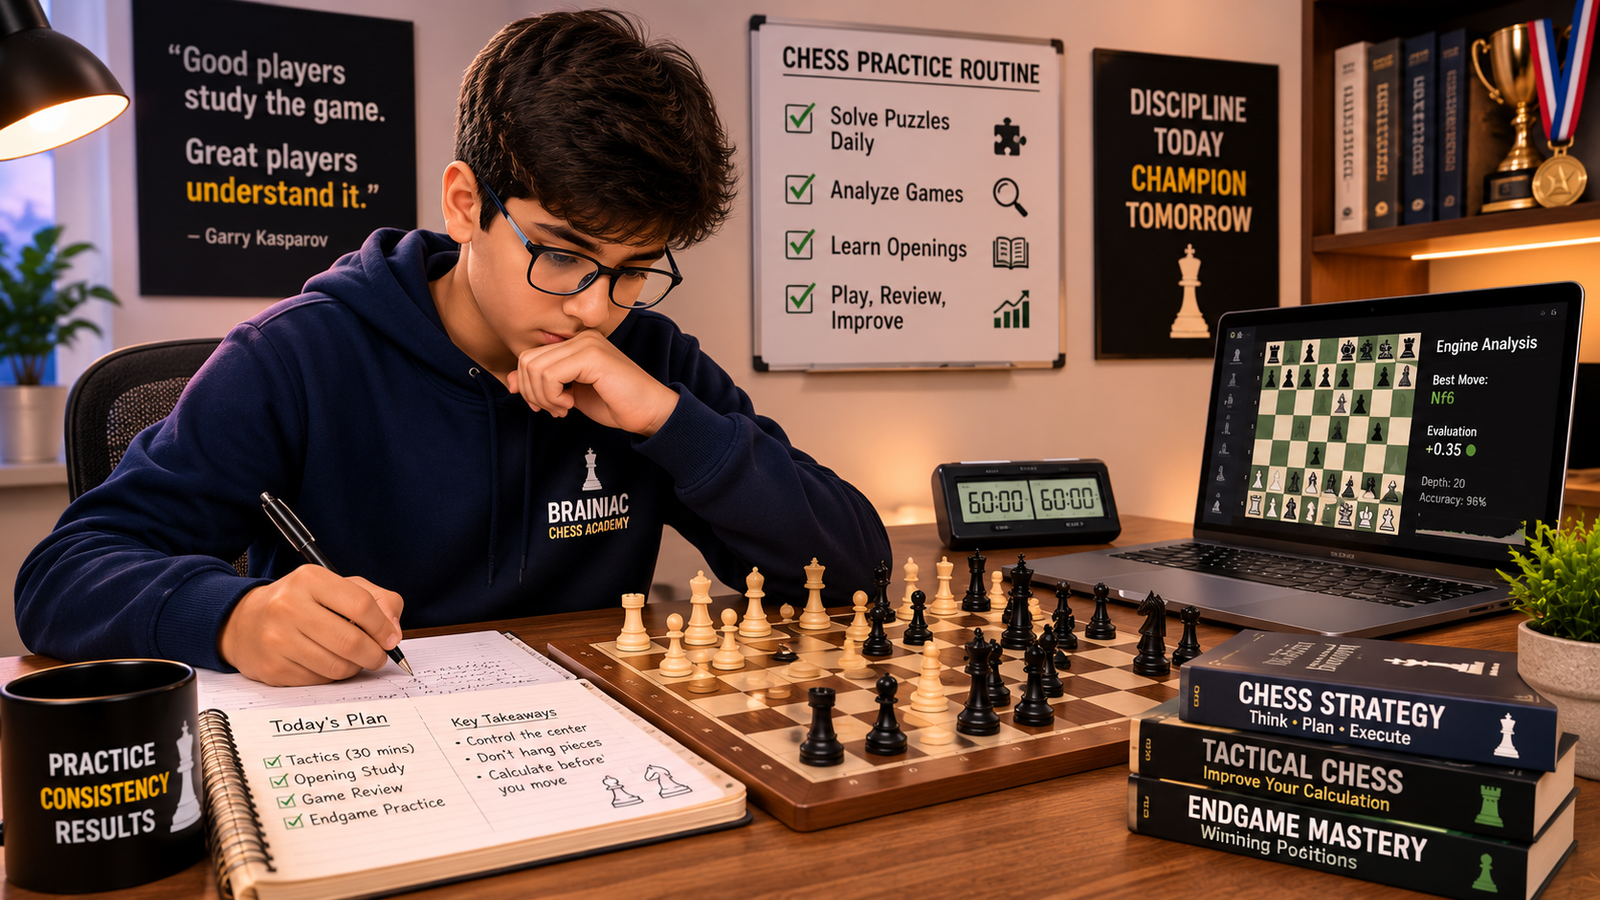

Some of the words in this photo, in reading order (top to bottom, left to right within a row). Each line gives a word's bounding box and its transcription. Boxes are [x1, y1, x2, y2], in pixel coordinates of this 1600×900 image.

[257, 52, 346, 87] players
[782, 46, 849, 71] CHESS
[857, 51, 952, 78] PRACTICE
[960, 59, 1040, 84] ROUTINE
[184, 86, 257, 119] study
[266, 89, 306, 116] the
[314, 97, 386, 124] game.
[1130, 88, 1247, 122] DISCIPLINE
[830, 106, 878, 127] Solve
[885, 109, 950, 130] Puzzles
[830, 132, 875, 156] Daily
[1154, 127, 1224, 157] TODAY
[186, 138, 258, 167] Great
[266, 143, 358, 177] players
[186, 176, 334, 208] understand
[830, 180, 900, 205] Analyze
[906, 183, 964, 203] Games
[1131, 164, 1247, 196] CHAMPION
[1126, 201, 1252, 233] TOMORROW
[205, 227, 251, 248] Garry
[256, 230, 328, 250] Kasparov
[831, 235, 881, 256] Learn
[887, 237, 968, 262] Openings
[831, 285, 874, 309] Play,
[881, 286, 946, 308] Review,
[831, 311, 904, 334] Improve
[1436, 339, 1478, 355] Engine
[1482, 336, 1538, 353] Analysis
[1433, 374, 1455, 385] Best
[1458, 374, 1488, 385] Move:
[1431, 391, 1454, 404] Nf6
[1427, 425, 1477, 437] Evaluation
[1426, 442, 1462, 456] +0.35
[1421, 476, 1451, 489] Depth:
[1453, 478, 1466, 488] 20
[548, 493, 629, 523] BRAINIAC
[968, 490, 1023, 514] 60:00
[1040, 487, 1094, 511] 60:00
[1419, 492, 1463, 507] Accuracy:
[1467, 496, 1487, 507] 96%
[549, 524, 583, 539] CHESS
[585, 516, 629, 535] ACADEMY
[1238, 681, 1313, 712] CHESS
[1320, 691, 1446, 730] STRATEGY
[269, 716, 340, 733] Today's
[346, 712, 388, 727] Plan
[451, 717, 478, 729] Key
[481, 708, 557, 725] Takeaways
[1250, 709, 1288, 728] Think
[1302, 717, 1334, 735] Plan
[1350, 724, 1411, 745] Execute
[466, 732, 516, 746] Control
[520, 729, 542, 739] the
[547, 724, 587, 736] center
[49, 742, 156, 776] PRACTICE
[286, 751, 340, 766] Tactics
[346, 747, 371, 761] (30
[377, 743, 415, 756] mins)
[477, 750, 515, 763] Don't
[519, 746, 556, 757] hang
[560, 738, 602, 754] pieces
[294, 769, 357, 787] Opening
[362, 763, 405, 777] Study
[489, 763, 554, 781] Calculate
[1202, 738, 1313, 780] TACTICAL
[1322, 758, 1403, 794] CHESS
[40, 771, 170, 810] CONSISTENCY
[302, 791, 346, 805] Game
[351, 784, 403, 798] Review
[499, 784, 525, 797] you
[531, 776, 567, 790] move
[1203, 765, 1261, 788] Improve
[1265, 776, 1299, 795] Your
[1303, 784, 1390, 812] Calculation
[309, 808, 378, 826] Endgame
[383, 798, 446, 815] Practice
[55, 808, 156, 844] RESULTS
[1188, 795, 1300, 838] ENDGAME
[1308, 817, 1428, 862] MASTERY
